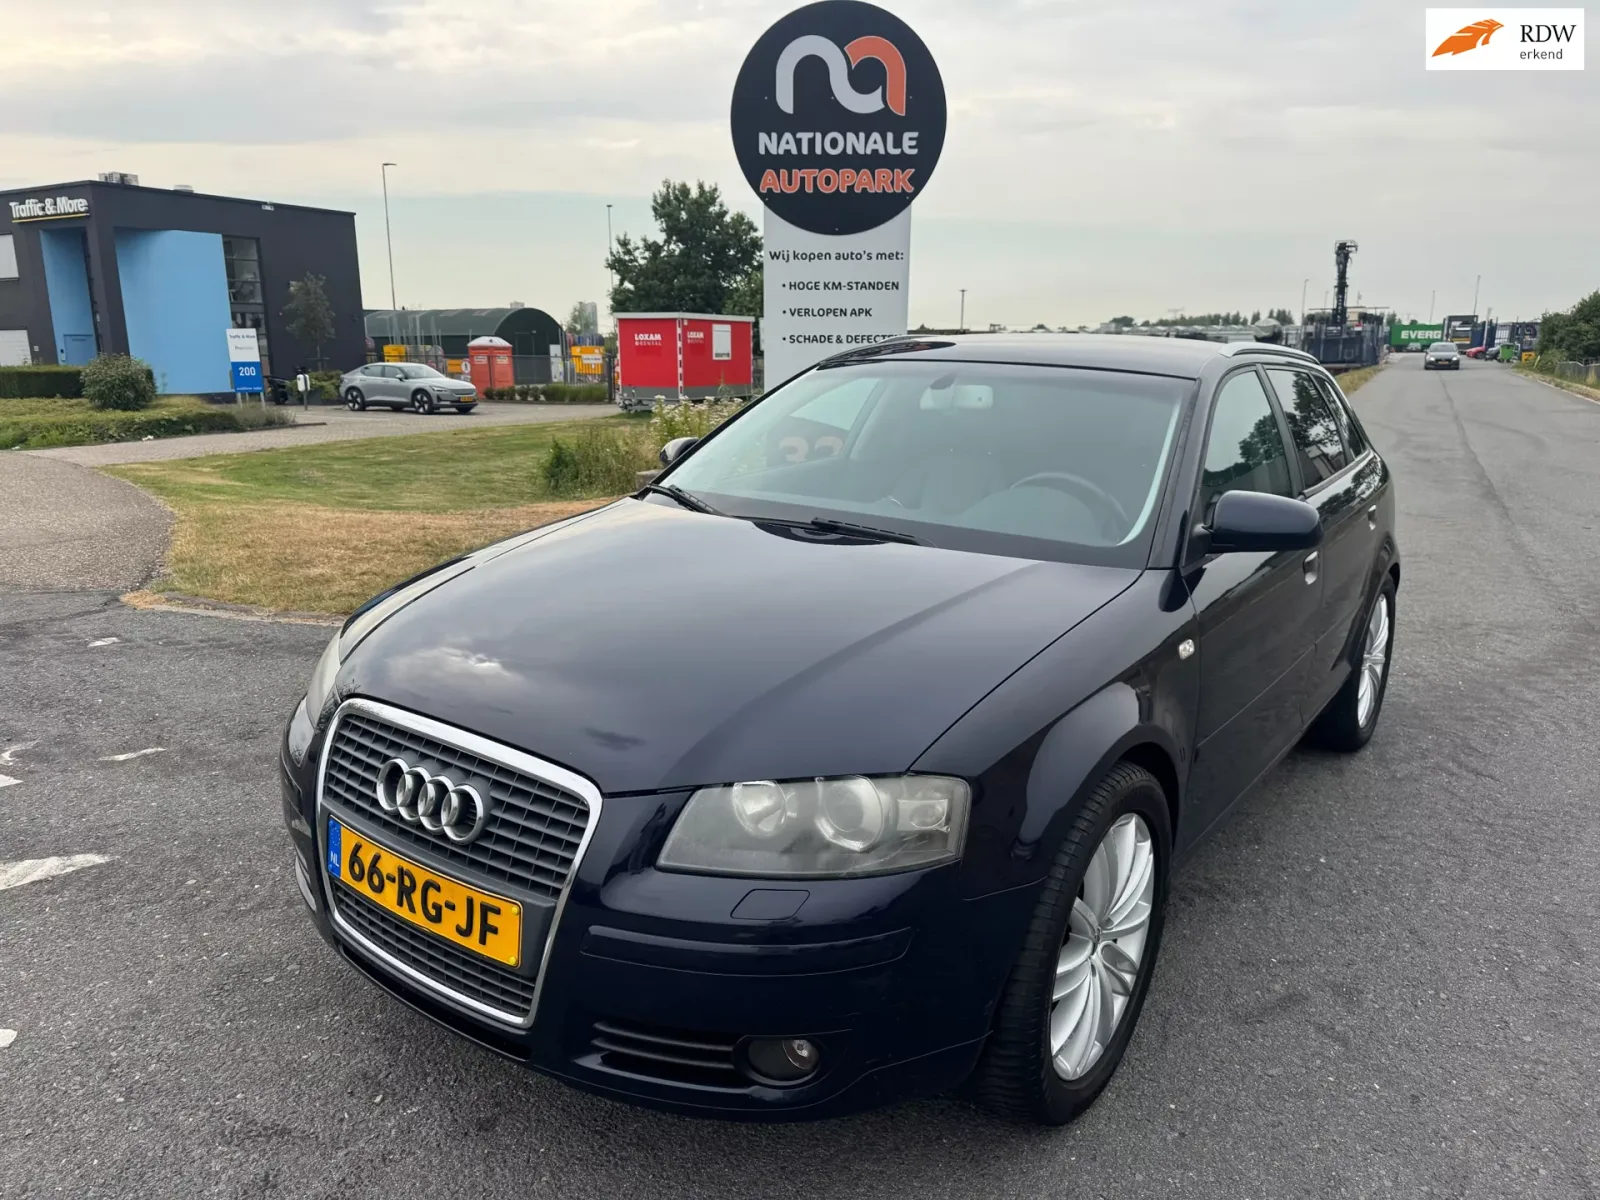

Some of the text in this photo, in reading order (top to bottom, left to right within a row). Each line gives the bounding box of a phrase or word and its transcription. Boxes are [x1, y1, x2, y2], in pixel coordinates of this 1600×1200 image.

[758, 131, 919, 155] NATIONALE
[760, 168, 915, 193] AUTOPARK
[9, 196, 88, 218] Traffic & More
[769, 250, 904, 263] Wij kopen auto's met:
[789, 281, 900, 291] HOGE KM-STANDEN
[789, 308, 873, 317] VERLOPEN APK
[634, 333, 662, 341] LOXAM
[687, 331, 704, 339] LOXAM
[789, 335, 833, 344] SCHADE
[835, 335, 843, 344] &
[239, 367, 256, 376] 200
[330, 851, 340, 868] NL
[348, 843, 502, 946] 66-RG-JF
